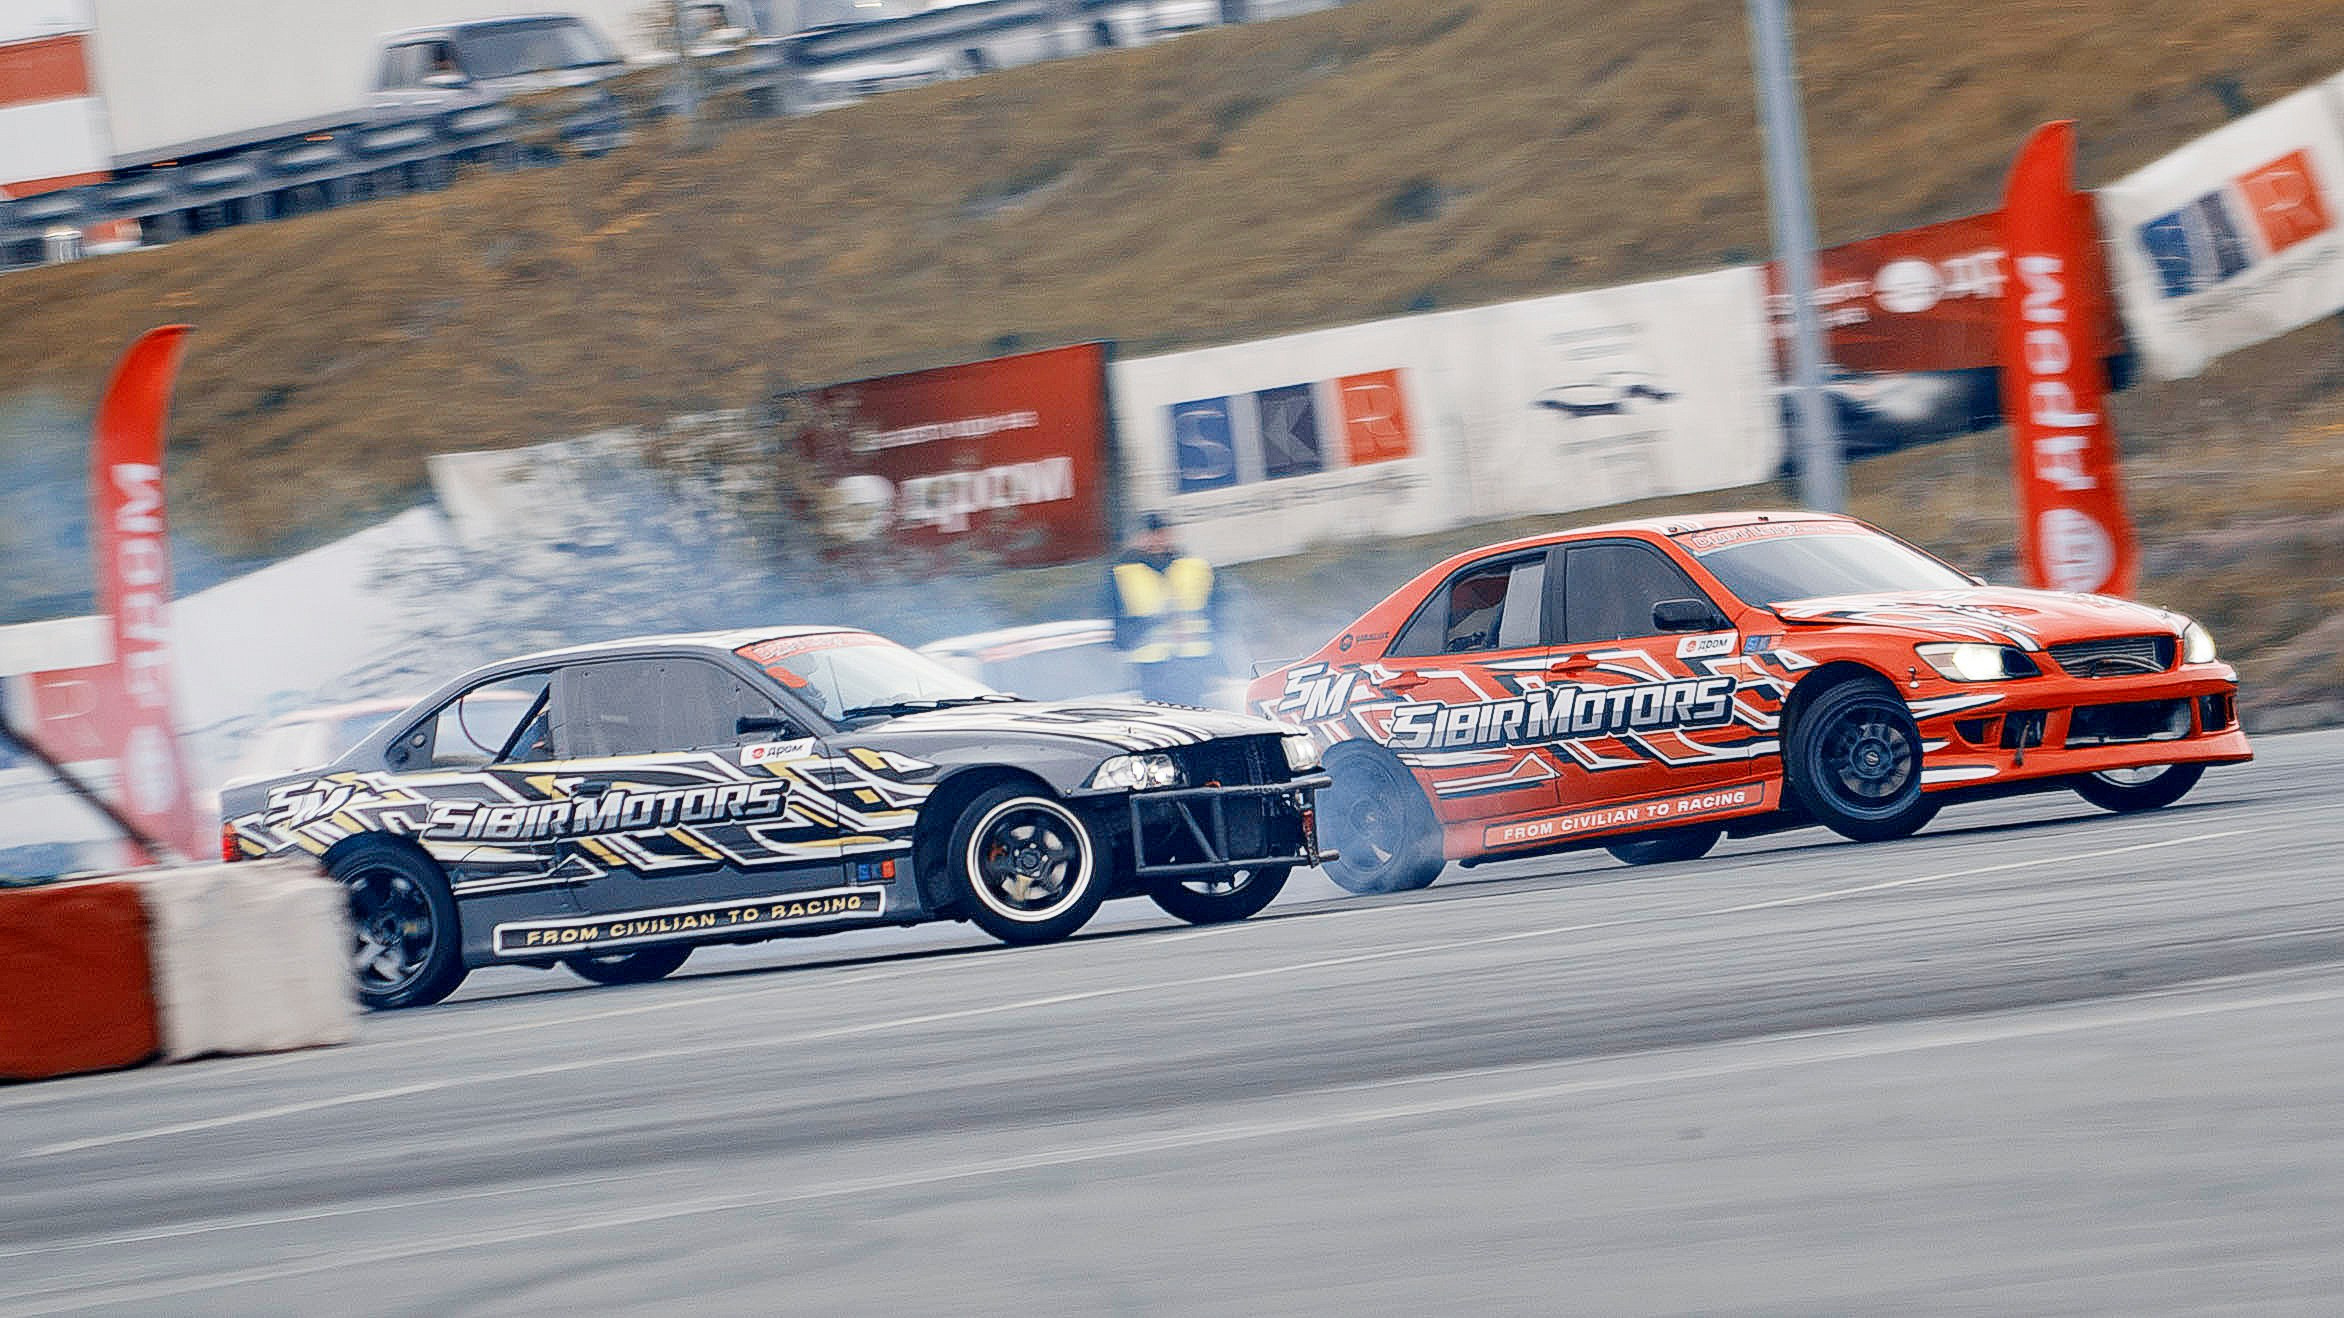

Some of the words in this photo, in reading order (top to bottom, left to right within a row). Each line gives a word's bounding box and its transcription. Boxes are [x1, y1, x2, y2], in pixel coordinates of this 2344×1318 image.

[1172, 380, 1408, 485] SKR
[1278, 662, 1358, 721] SM
[1389, 702, 1526, 748] SIBIR
[1526, 678, 1731, 738] MOTORS
[427, 798, 572, 840] SIBIR
[570, 780, 788, 833] MOTORS
[1503, 823, 1553, 841] FROM
[1561, 808, 1639, 832] CIVILIAN
[1647, 803, 1669, 817] TO
[1677, 791, 1746, 813] RACING
[526, 925, 598, 946] FROM
[609, 912, 716, 938] CIVILIAN
[728, 906, 760, 923] TO
[771, 895, 862, 919] RACING
